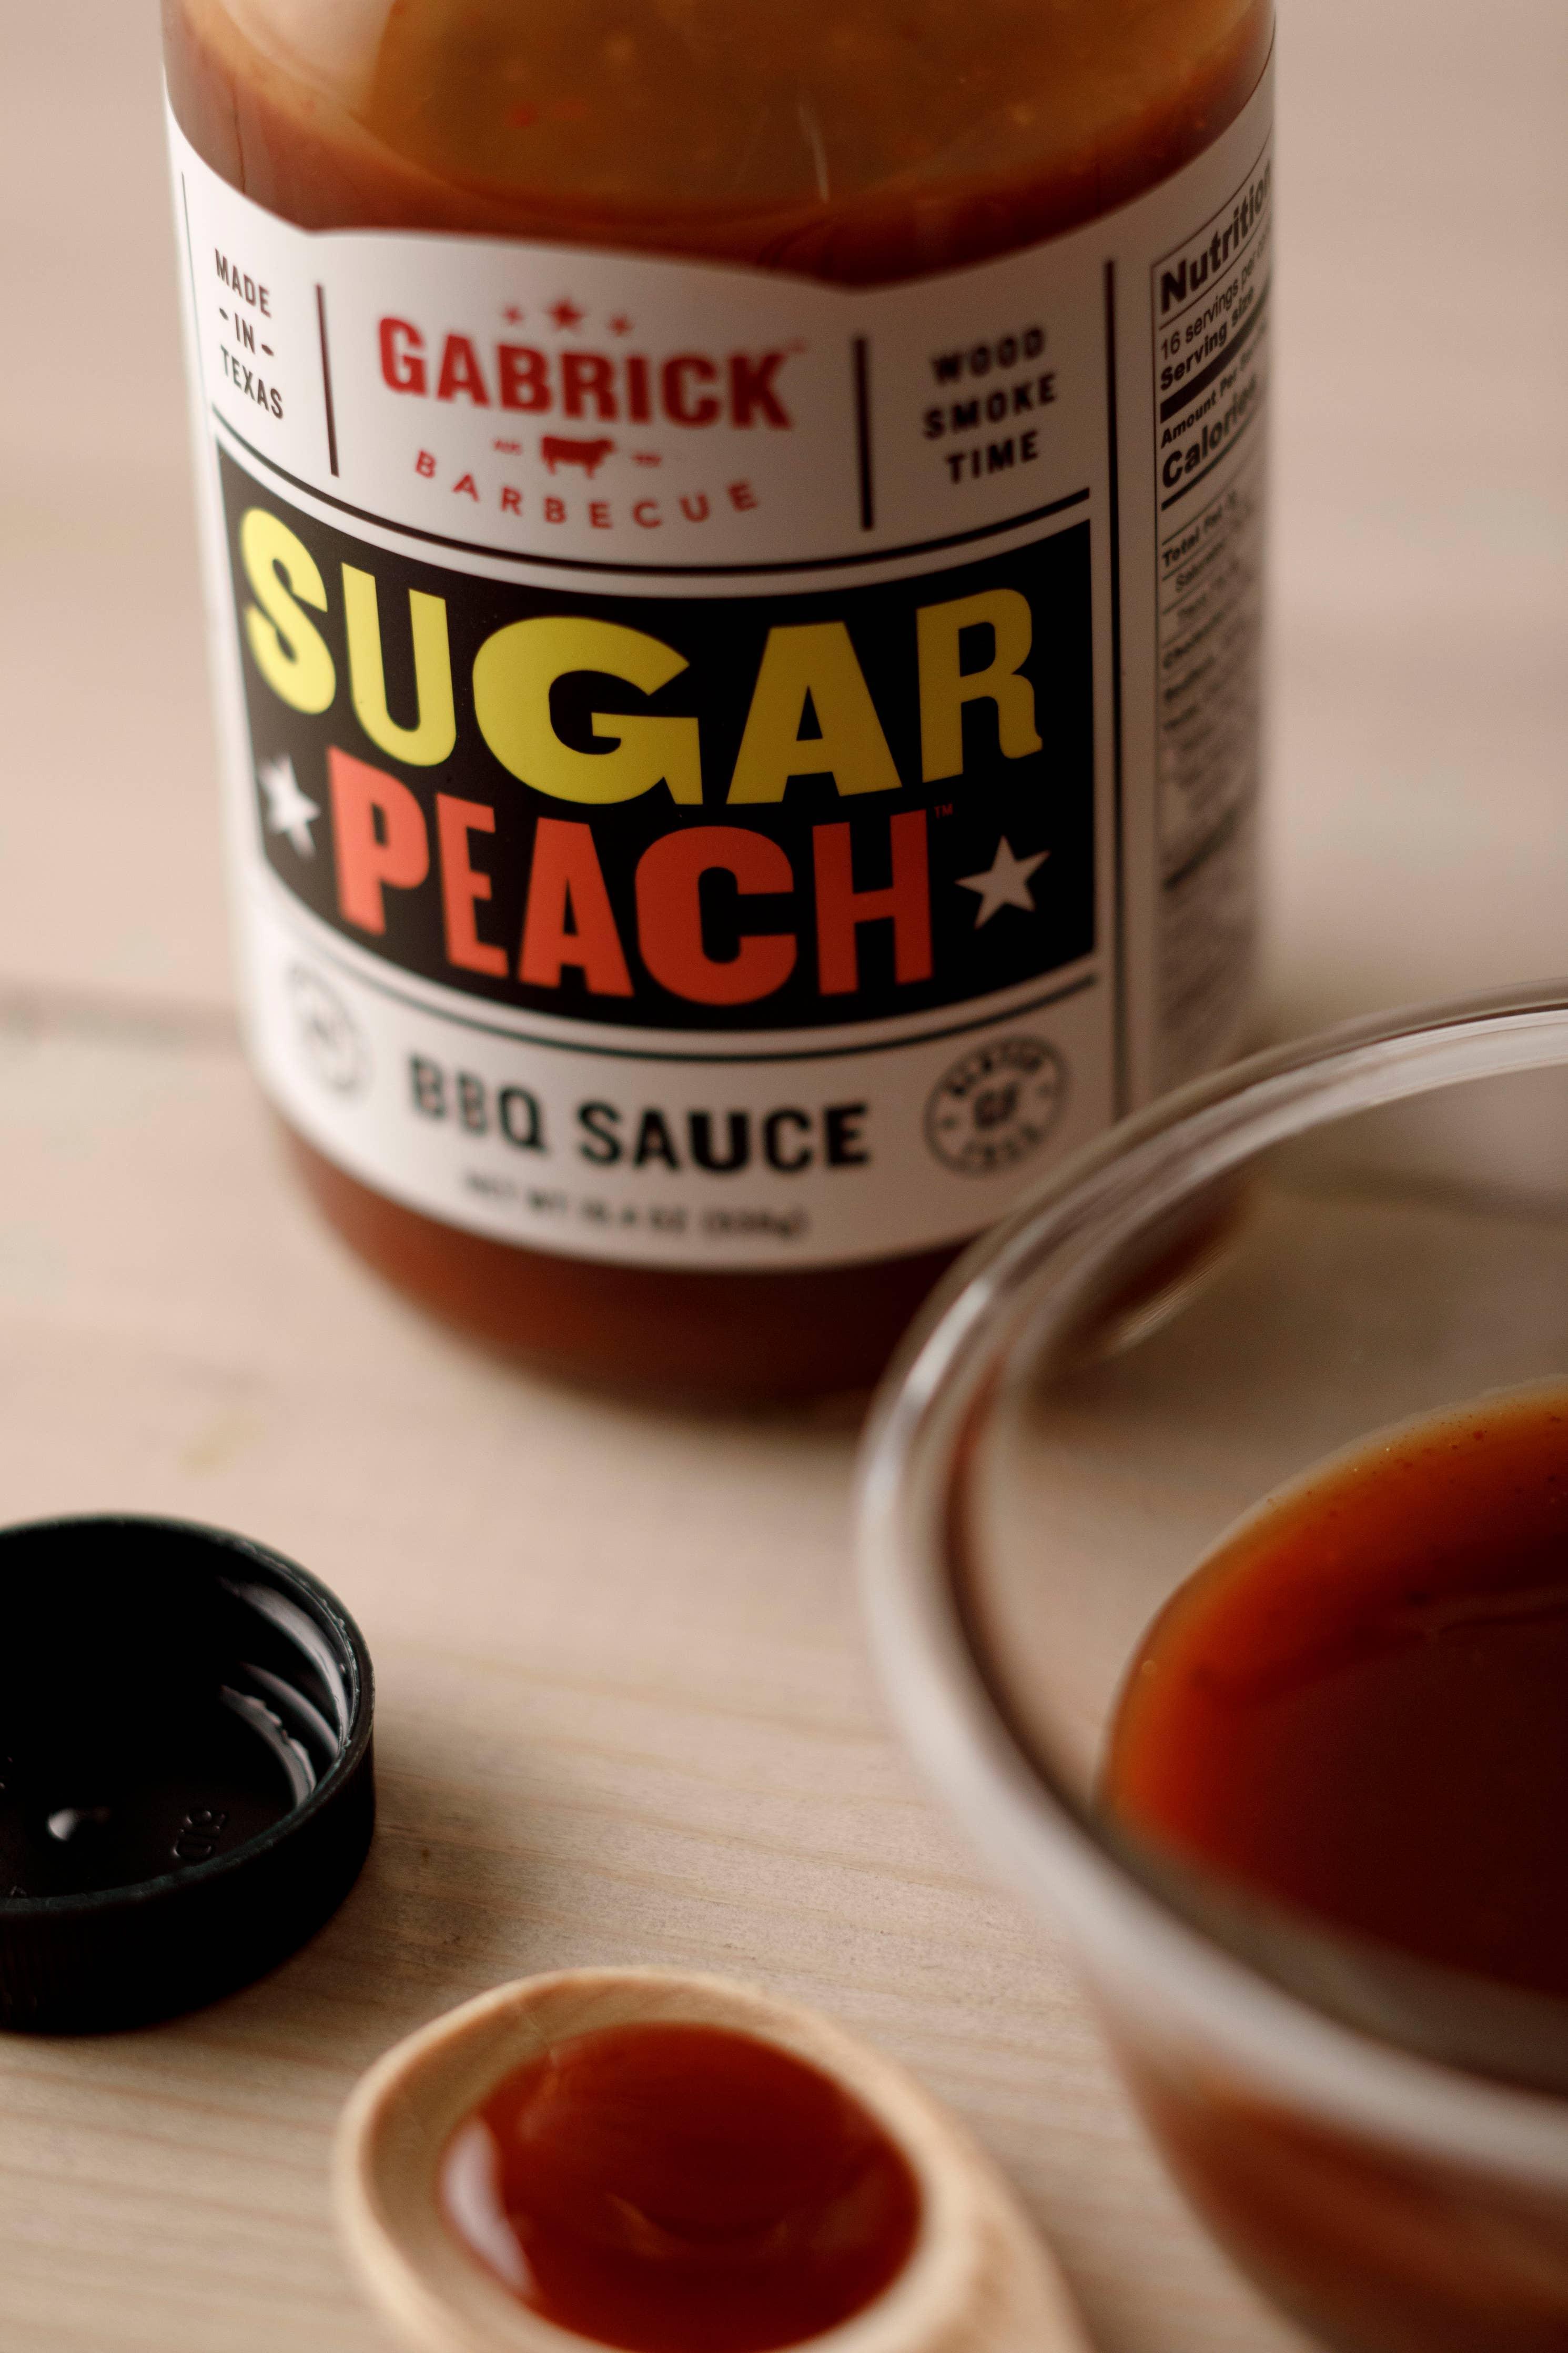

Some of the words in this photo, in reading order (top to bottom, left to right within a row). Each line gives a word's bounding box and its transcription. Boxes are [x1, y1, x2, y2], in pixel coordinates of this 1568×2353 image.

[215, 248, 271, 319] MADE
[1161, 331, 1181, 361] 16
[1186, 279, 1238, 344] servings
[220, 345, 283, 419] TEXAS
[378, 317, 793, 430] GABRICK
[932, 325, 1045, 386] WOOD
[1160, 321, 1227, 391] Serving
[923, 371, 1056, 440] SMOKE
[1160, 389, 1217, 449] Amount
[414, 450, 758, 529] BARBECUE
[945, 429, 1039, 484] TIME
[240, 508, 1043, 806] SUGAR
[327, 746, 933, 1006] PEACH
[410, 1053, 547, 1155] BBQ
[577, 1100, 871, 1176] SAUCE
